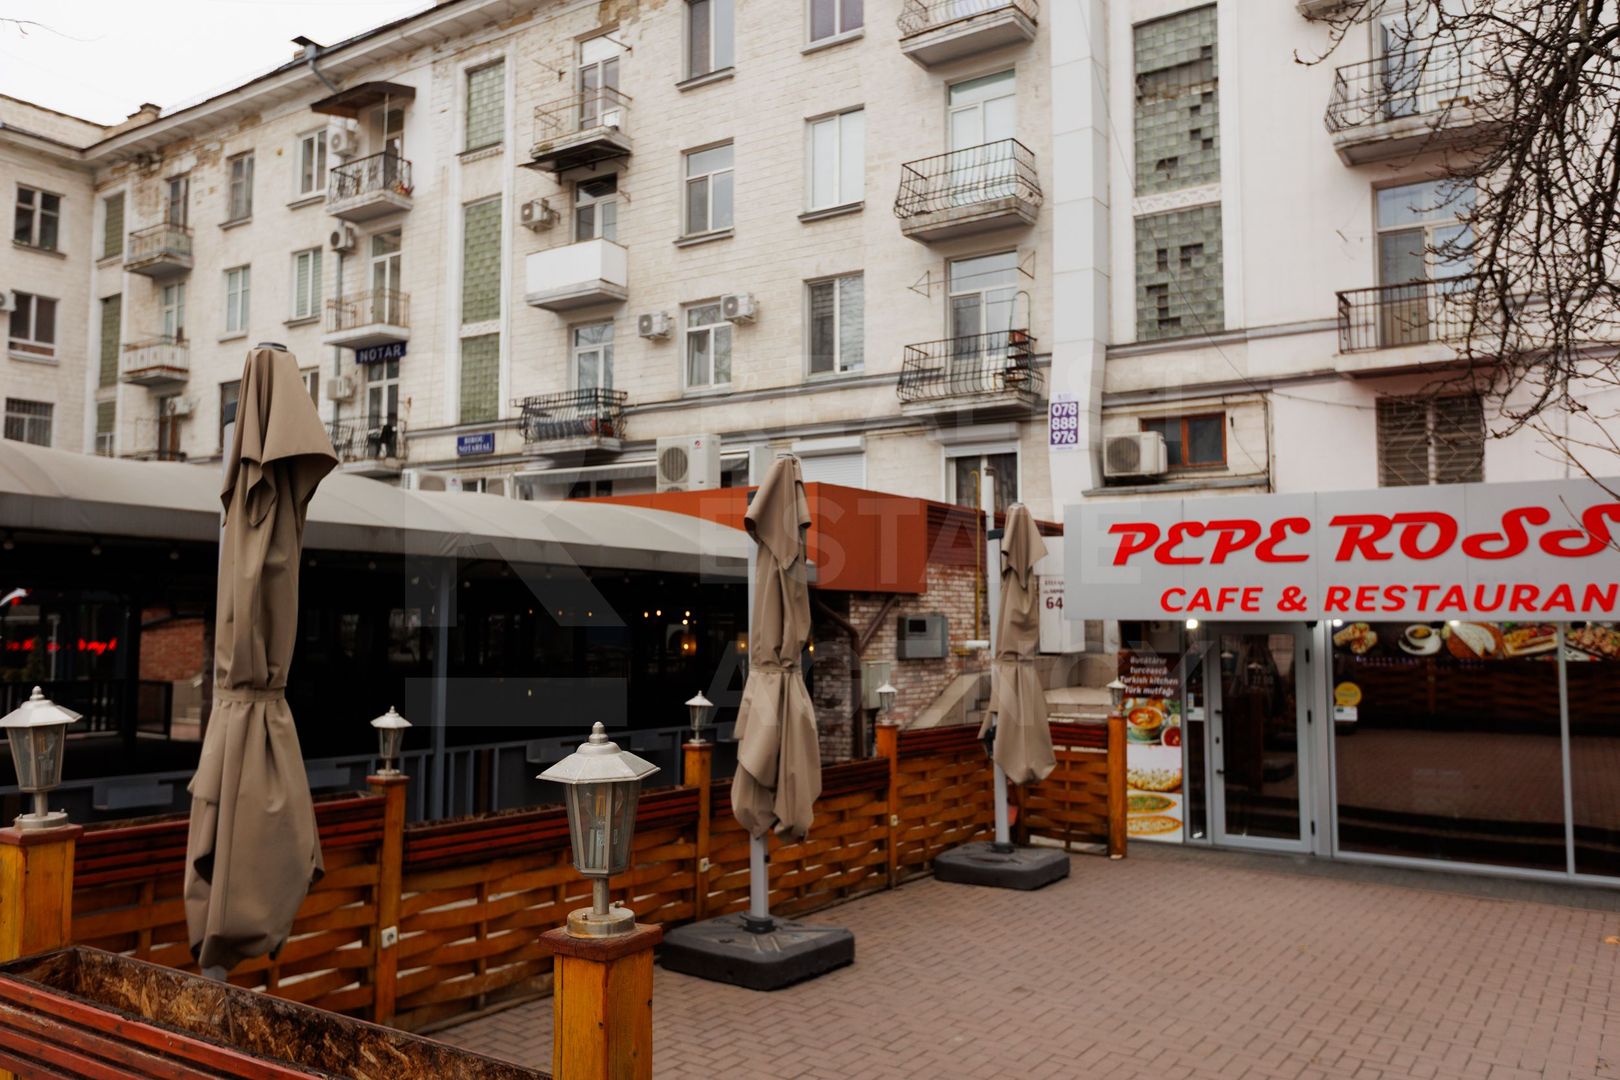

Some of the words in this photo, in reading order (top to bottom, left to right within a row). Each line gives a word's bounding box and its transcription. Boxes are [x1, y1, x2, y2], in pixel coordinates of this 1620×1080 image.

[359, 344, 402, 362] NOTAR
[1052, 402, 1077, 416] 078
[1052, 416, 1077, 430] 888
[1052, 430, 1077, 444] 976
[1107, 516, 1311, 566] PEPE
[1045, 596, 1063, 610] 64
[1160, 586, 1263, 613] CAFE
[1276, 585, 1308, 613] &
